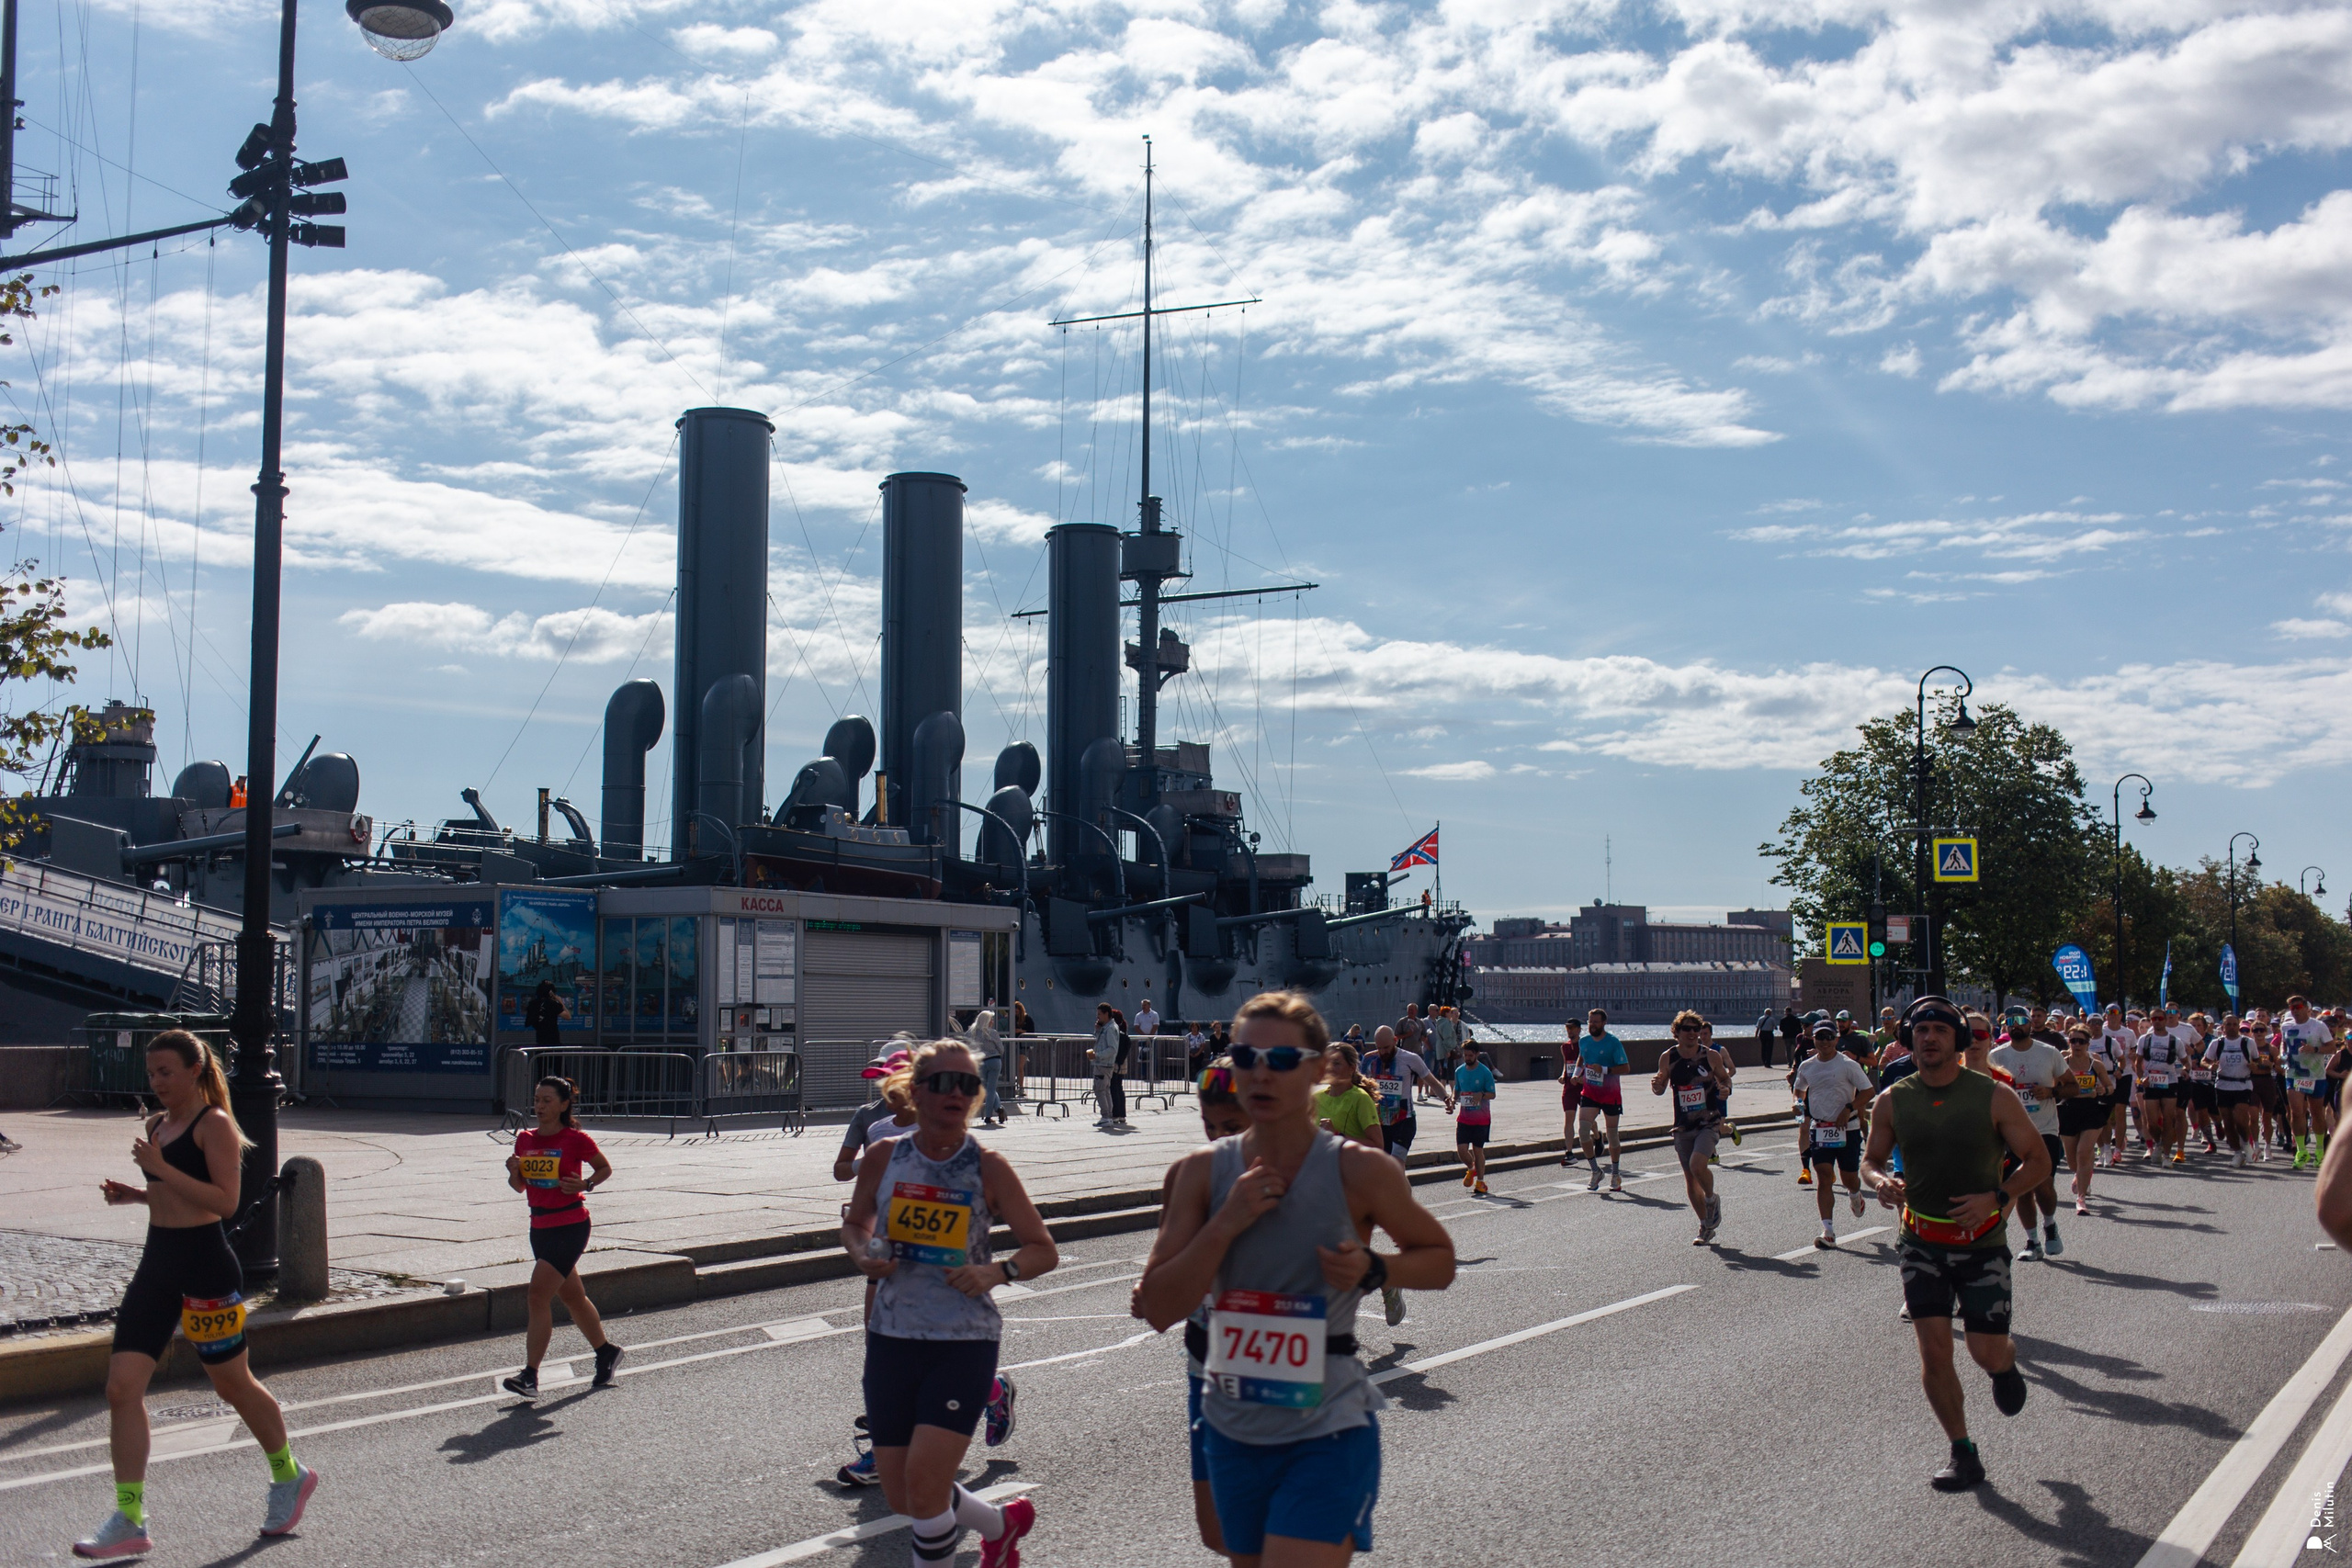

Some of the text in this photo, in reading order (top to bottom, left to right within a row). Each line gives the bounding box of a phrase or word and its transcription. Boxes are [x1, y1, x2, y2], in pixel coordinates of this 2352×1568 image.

[741, 896, 784, 912] КАССА
[351, 909, 453, 919] ЦЕНТРАЛЬНЫЙ ВОЕННО-МОРСКОЙ МУЗЕЙ
[1379, 1081, 1399, 1090] 5632
[1680, 1091, 1702, 1103] 7637
[1823, 1129, 1839, 1138] 786
[524, 1159, 554, 1172] 3023
[897, 1205, 959, 1234] 4567
[190, 1311, 238, 1333] 3999
[1224, 1326, 1308, 1367] 7470
